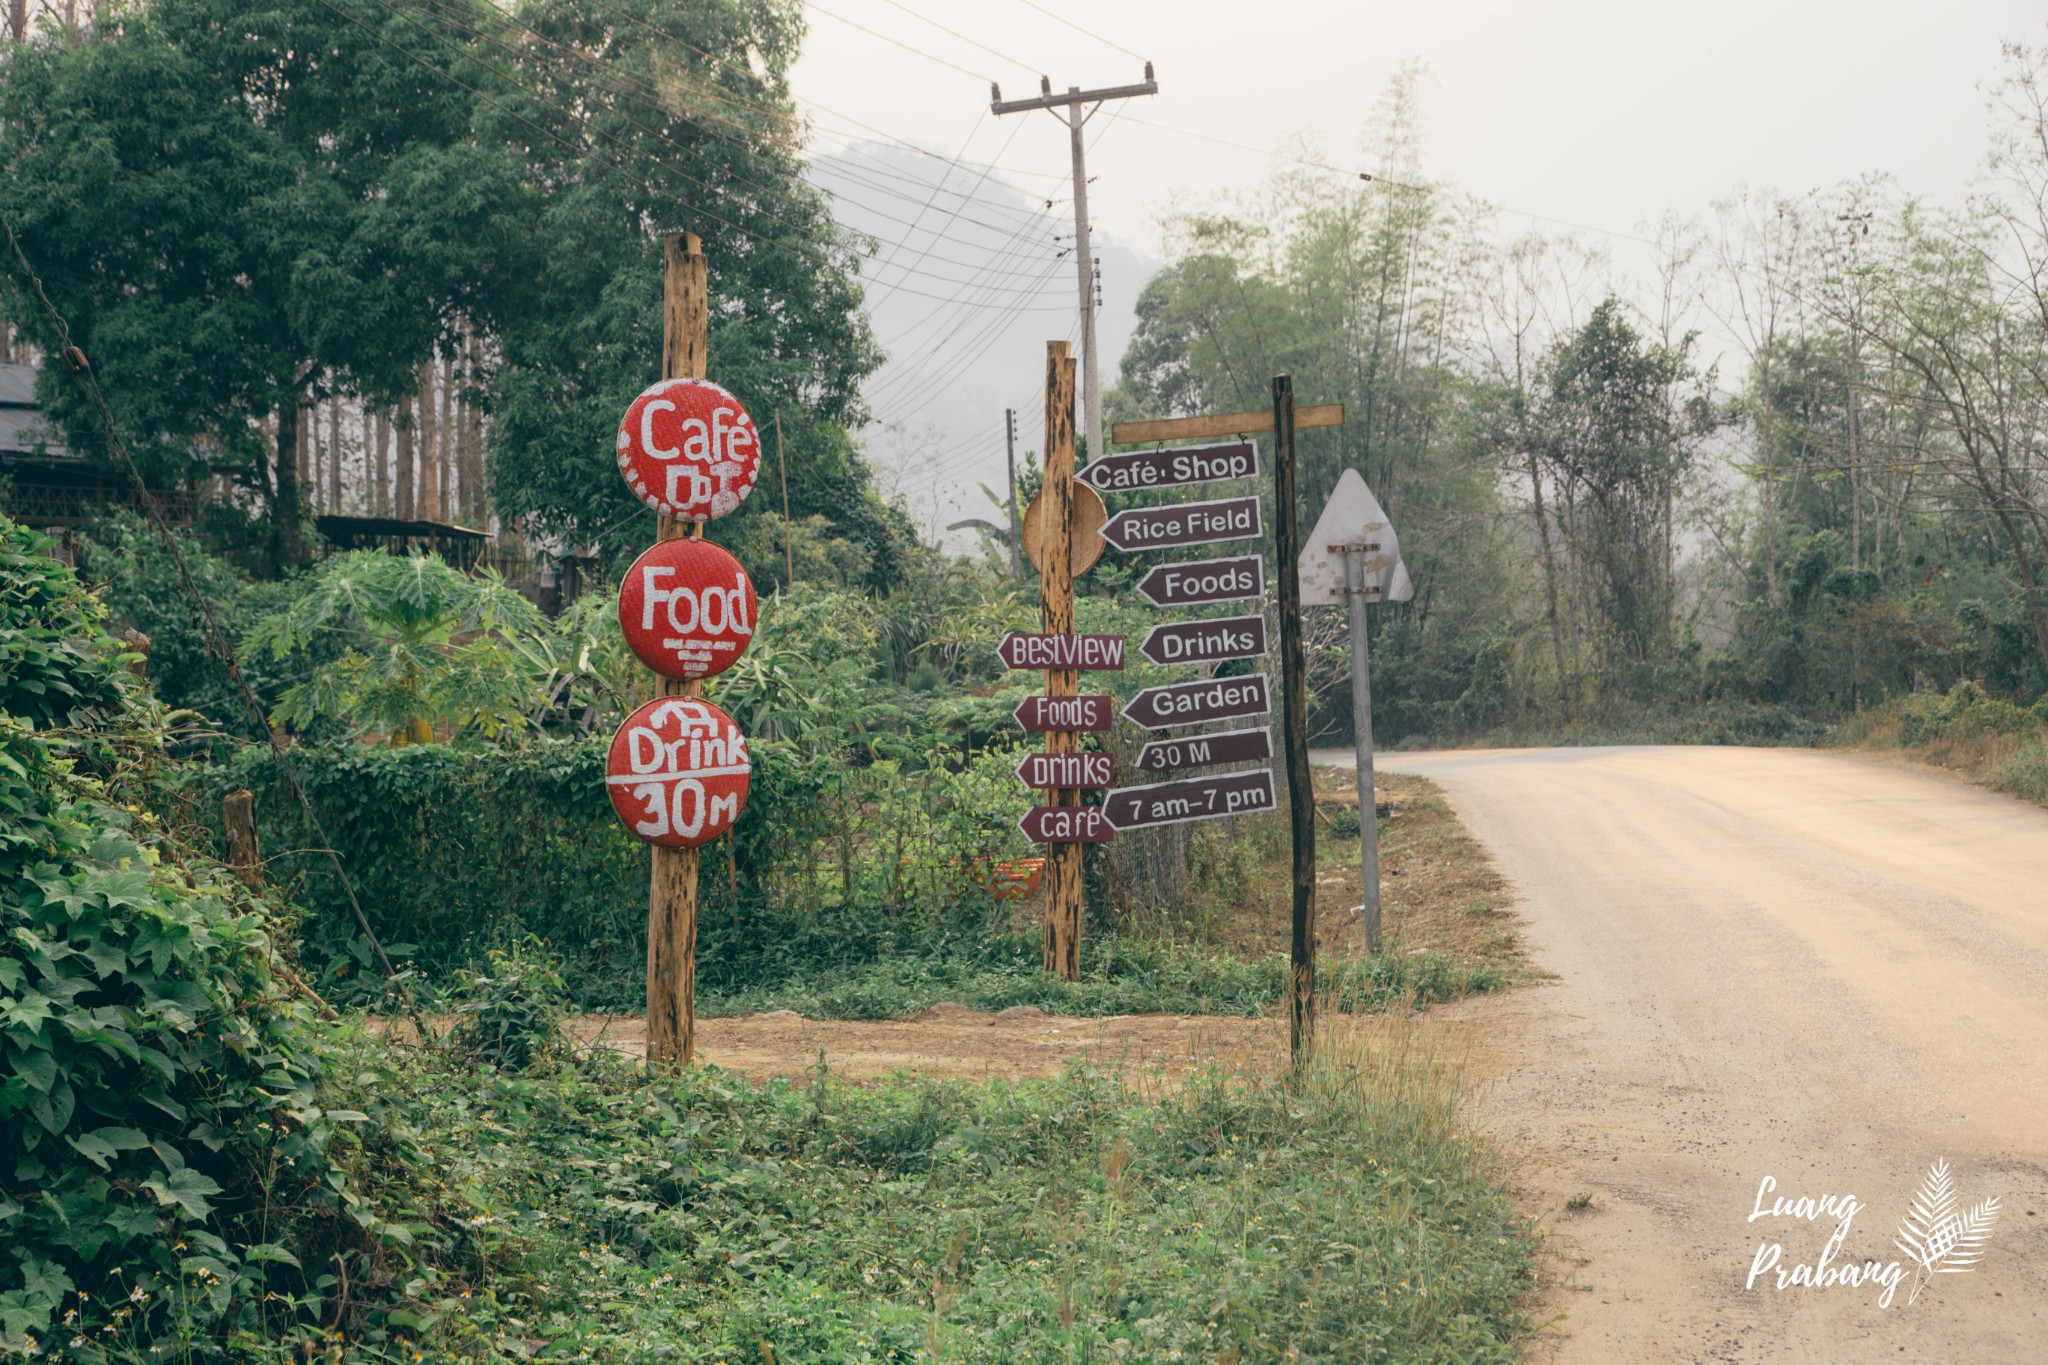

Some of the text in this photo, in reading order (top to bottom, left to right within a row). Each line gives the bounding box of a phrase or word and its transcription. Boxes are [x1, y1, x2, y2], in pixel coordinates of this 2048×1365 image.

[641, 399, 752, 464] Café
[1091, 455, 1248, 489] Café Shop
[1123, 508, 1251, 541] Rice Field
[1165, 567, 1254, 597] Foods
[642, 566, 752, 635] Food
[1162, 628, 1255, 658] Drinks
[1036, 696, 1097, 727] Foods
[1152, 684, 1259, 715] Garden
[628, 724, 749, 774] Drink
[1150, 741, 1211, 768] 30 M
[1033, 753, 1111, 785] Drinks
[1226, 787, 1265, 813] pm
